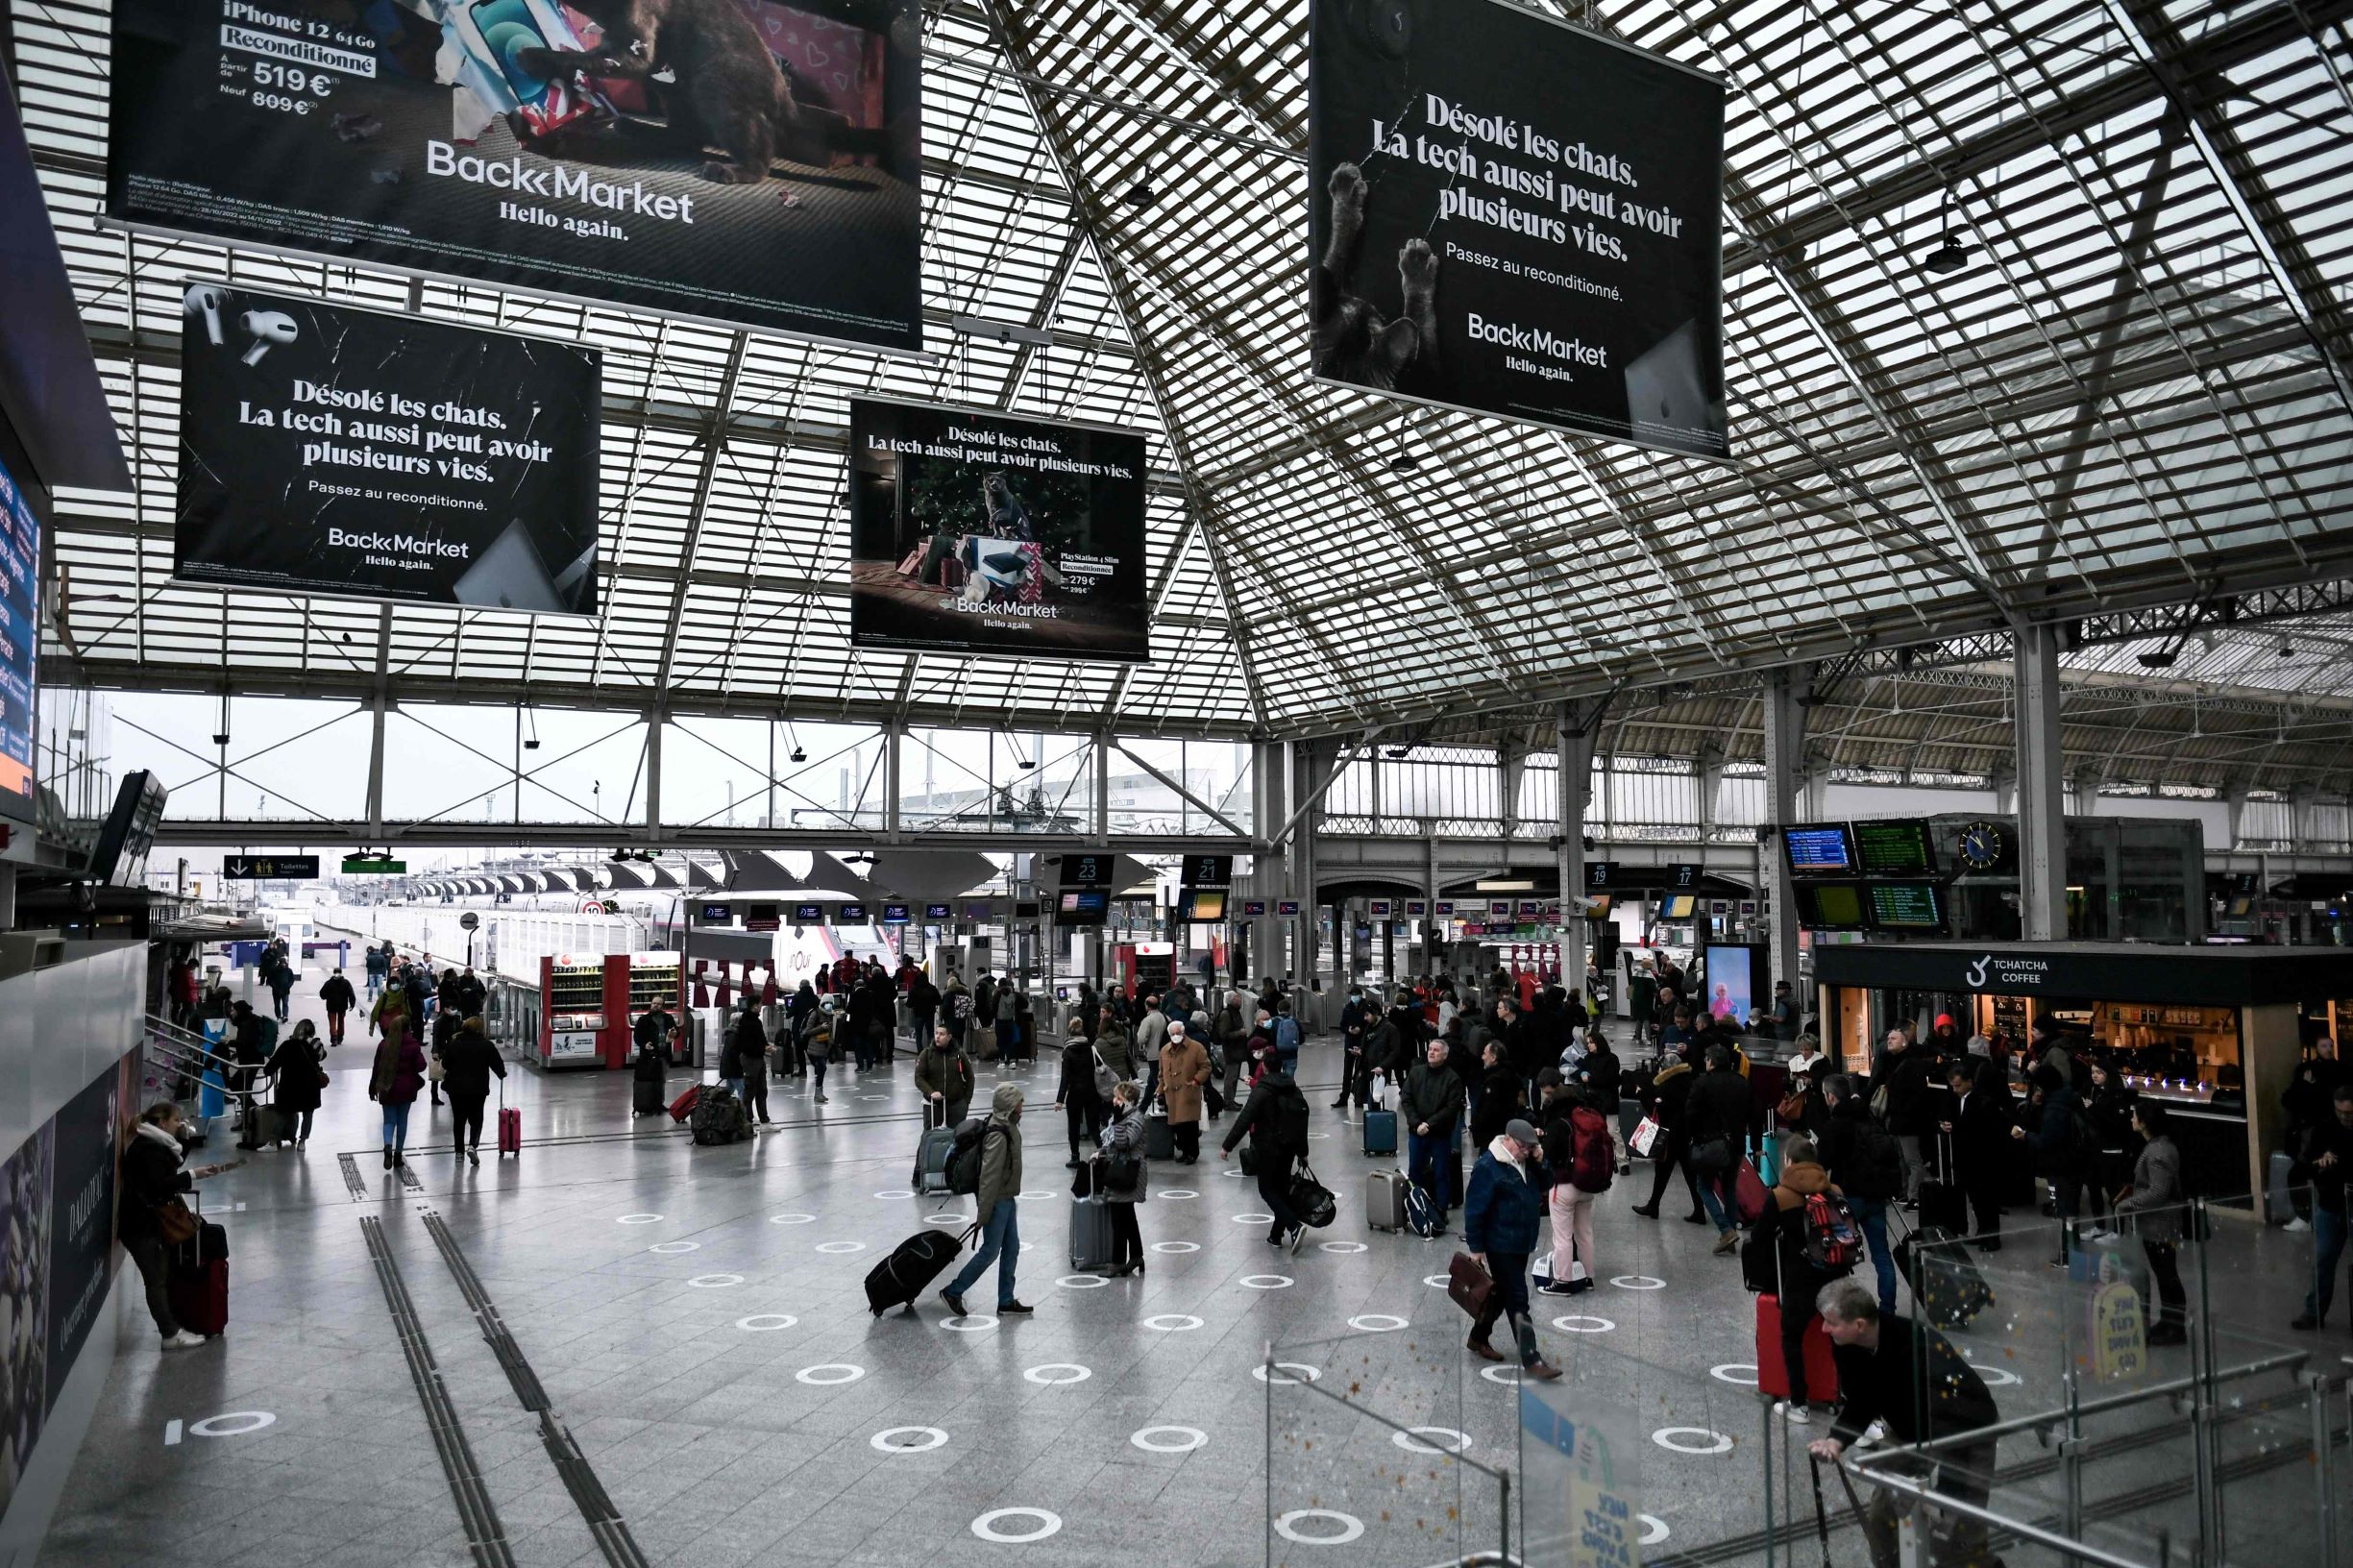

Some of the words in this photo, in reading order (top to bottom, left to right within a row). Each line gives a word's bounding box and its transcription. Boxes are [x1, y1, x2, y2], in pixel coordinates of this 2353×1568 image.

[224, 0, 302, 32] iPhone
[307, 22, 330, 38] 12
[336, 32, 353, 45] 64
[355, 36, 376, 49] Go
[226, 28, 372, 73] Reconditionné
[220, 62, 248, 73] partir
[221, 69, 233, 78] de
[220, 85, 247, 96] Neuf
[1426, 93, 1517, 150] Désolé
[1524, 124, 1559, 162] les
[1564, 140, 1637, 188] chats.
[1372, 119, 1409, 159] La
[1416, 134, 1477, 180] tech
[1484, 159, 1554, 201] aussi
[1560, 183, 1616, 221] peut
[1621, 199, 1682, 239] avoir
[500, 201, 558, 229] Hello
[563, 217, 629, 242] again.
[1439, 188, 1566, 245] plusieurs
[1572, 223, 1628, 262] vies.
[1446, 242, 1498, 270] Passez
[1503, 258, 1520, 276] au
[1525, 263, 1623, 303] reconditionné.
[1506, 355, 1536, 376] Hello
[1538, 365, 1574, 383] again.
[292, 379, 384, 412] Désolé
[390, 393, 426, 419] les
[431, 401, 507, 430] chats.
[239, 401, 275, 427] La
[282, 408, 342, 436] tech
[349, 419, 420, 446] aussi
[426, 431, 483, 454] peut
[488, 440, 553, 463] avoir
[947, 426, 996, 446] Désolé
[999, 432, 1018, 448] les
[1020, 436, 1062, 453] chats.
[302, 441, 430, 475] plusieurs
[436, 458, 495, 483] vies.
[869, 435, 888, 451] La
[890, 436, 922, 455] tech
[924, 445, 963, 459] aussi
[966, 450, 997, 464] peut
[1000, 453, 1037, 468] avoir
[1039, 455, 1100, 478] plusieurs
[1104, 465, 1133, 479] vies.
[308, 480, 361, 499] Passez
[365, 488, 383, 500] au
[387, 489, 488, 512] reconditionné.
[365, 554, 396, 569] Hello
[398, 559, 433, 572] again.
[984, 618, 1004, 628] Hello
[1007, 621, 1032, 630] again.
[1078, 865, 1096, 878] 23
[1199, 865, 1214, 878] 21
[1594, 870, 1605, 883] 19
[1679, 871, 1691, 884] 17
[1994, 960, 2048, 970] TCHATCHA
[2001, 973, 2041, 983] COFFEE
